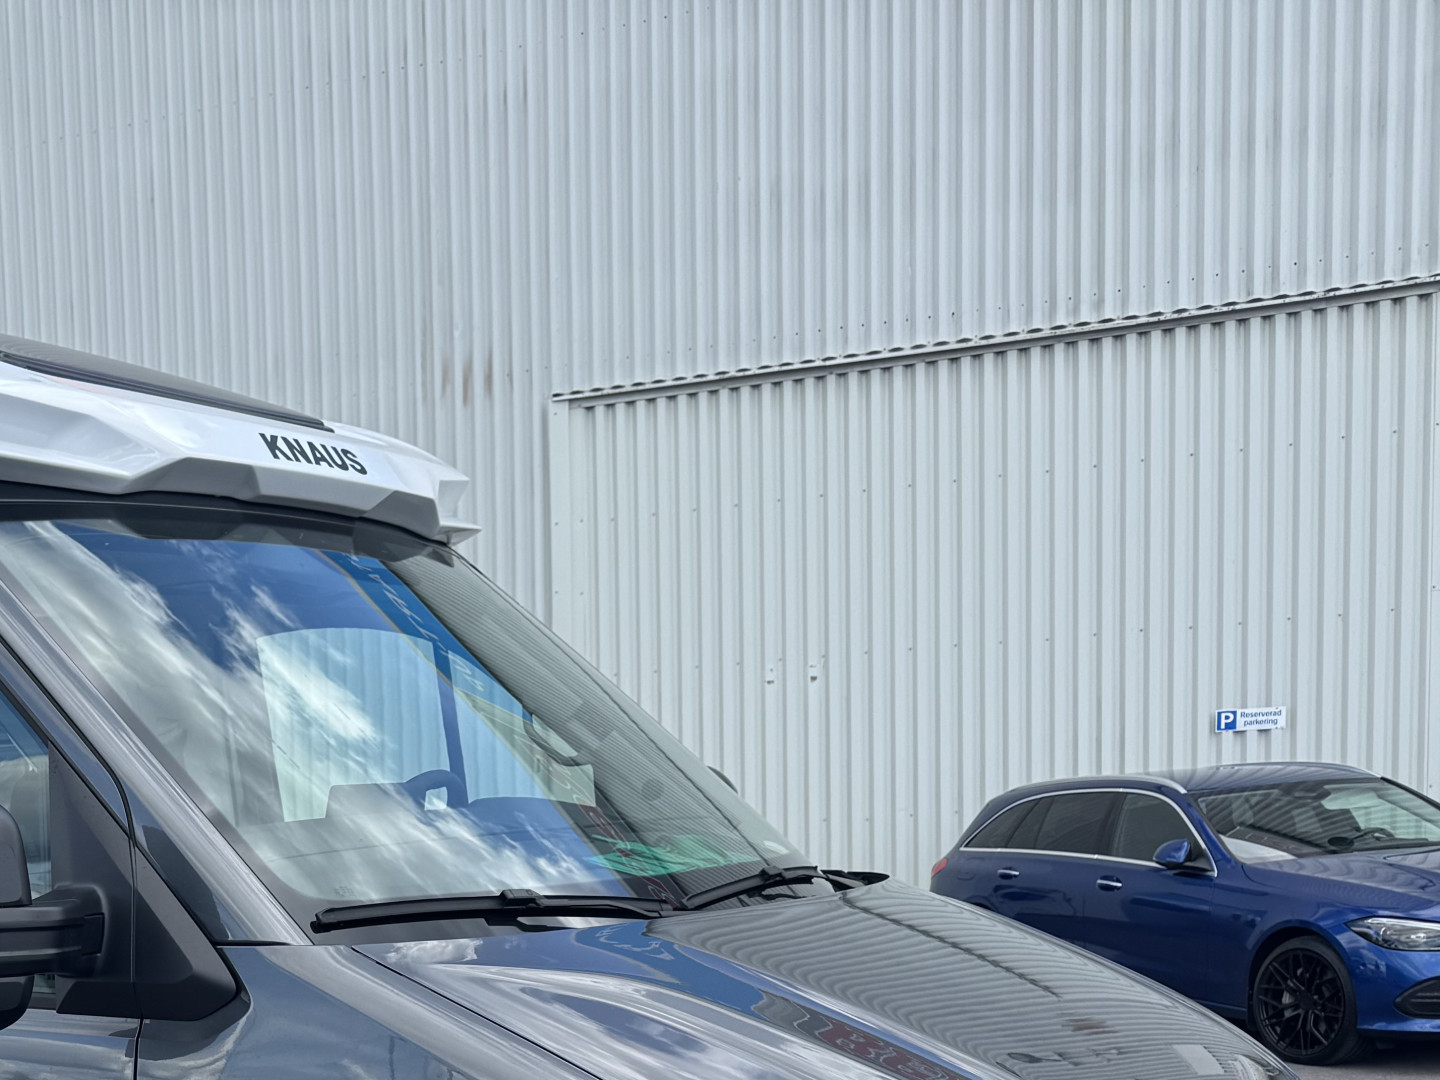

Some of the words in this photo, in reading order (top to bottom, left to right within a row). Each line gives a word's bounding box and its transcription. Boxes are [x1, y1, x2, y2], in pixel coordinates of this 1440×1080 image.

[258, 433, 368, 475] KNAUS
[1240, 709, 1282, 718] Reserverad
[1243, 718, 1278, 727] parkering
